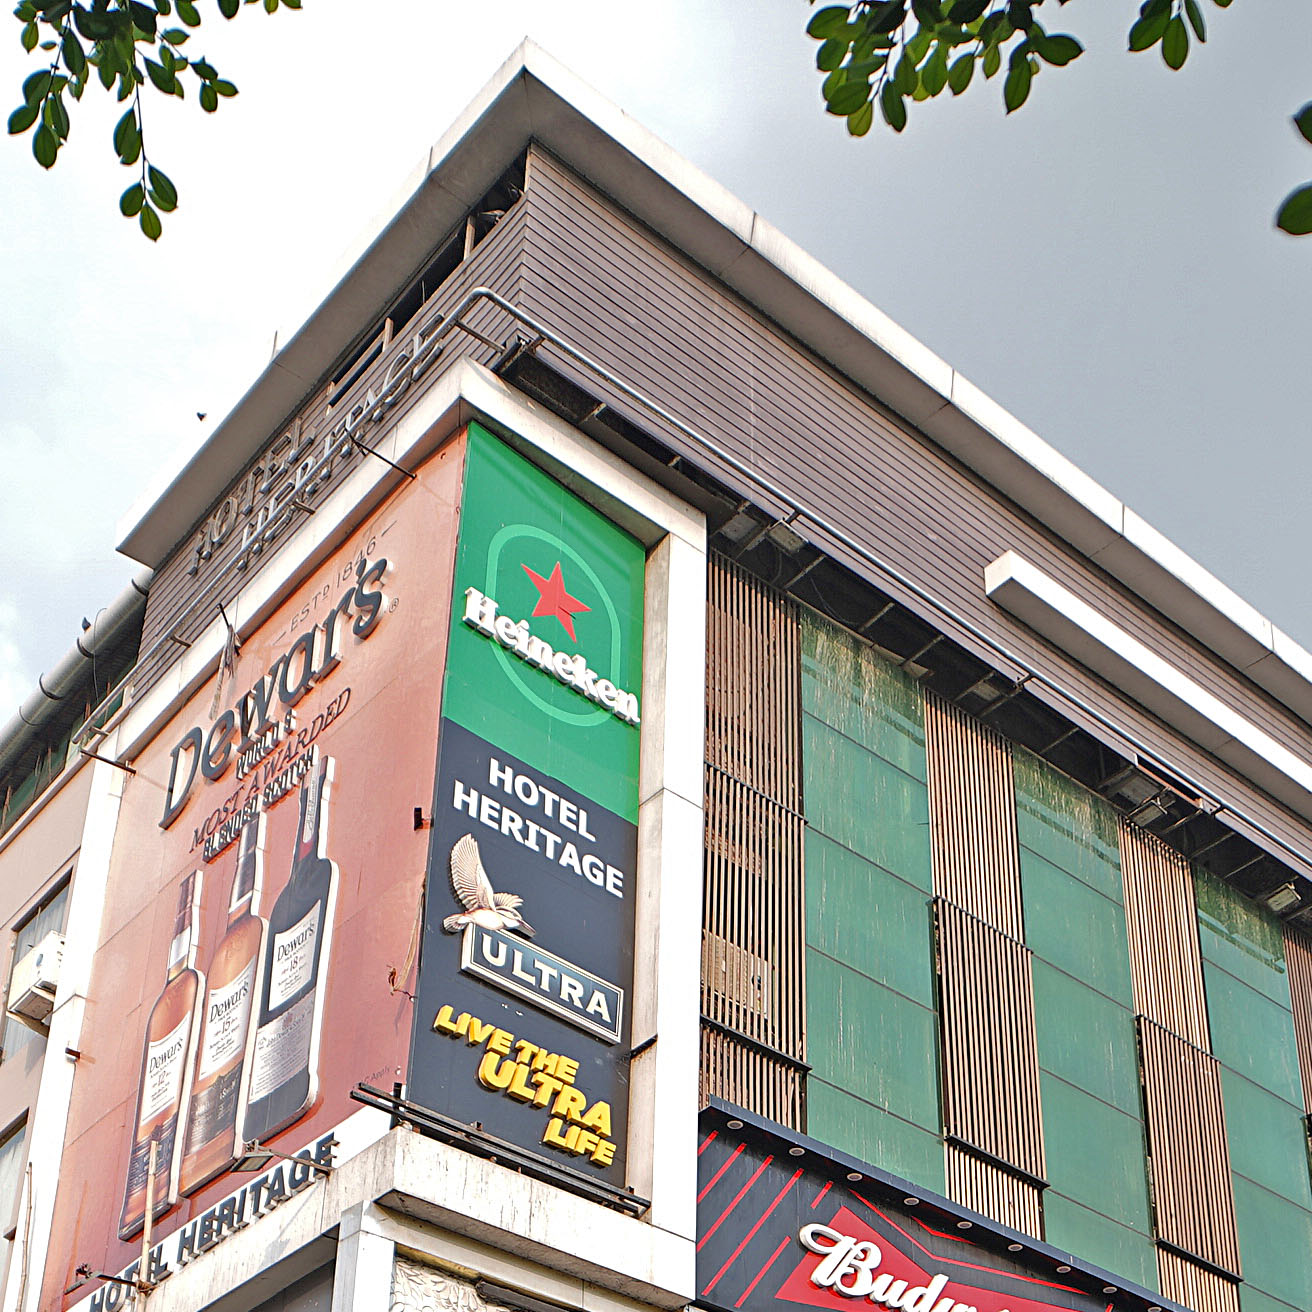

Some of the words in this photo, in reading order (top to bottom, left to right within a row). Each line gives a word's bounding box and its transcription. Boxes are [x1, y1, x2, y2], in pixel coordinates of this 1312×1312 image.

[158, 557, 392, 831] Dewar's
[462, 586, 641, 727] Heineken
[190, 786, 245, 853] MOST
[244, 687, 352, 803] AWARDED
[489, 757, 597, 842] HOTEL
[453, 779, 624, 899] HERITAGE
[482, 932, 612, 1024] ULTRA
[433, 1005, 515, 1057] LIVE
[516, 1039, 580, 1086] THE
[478, 1051, 612, 1138] ULTRA
[543, 1117, 617, 1167] LIFE
[177, 1132, 339, 1266] HERITAGE
